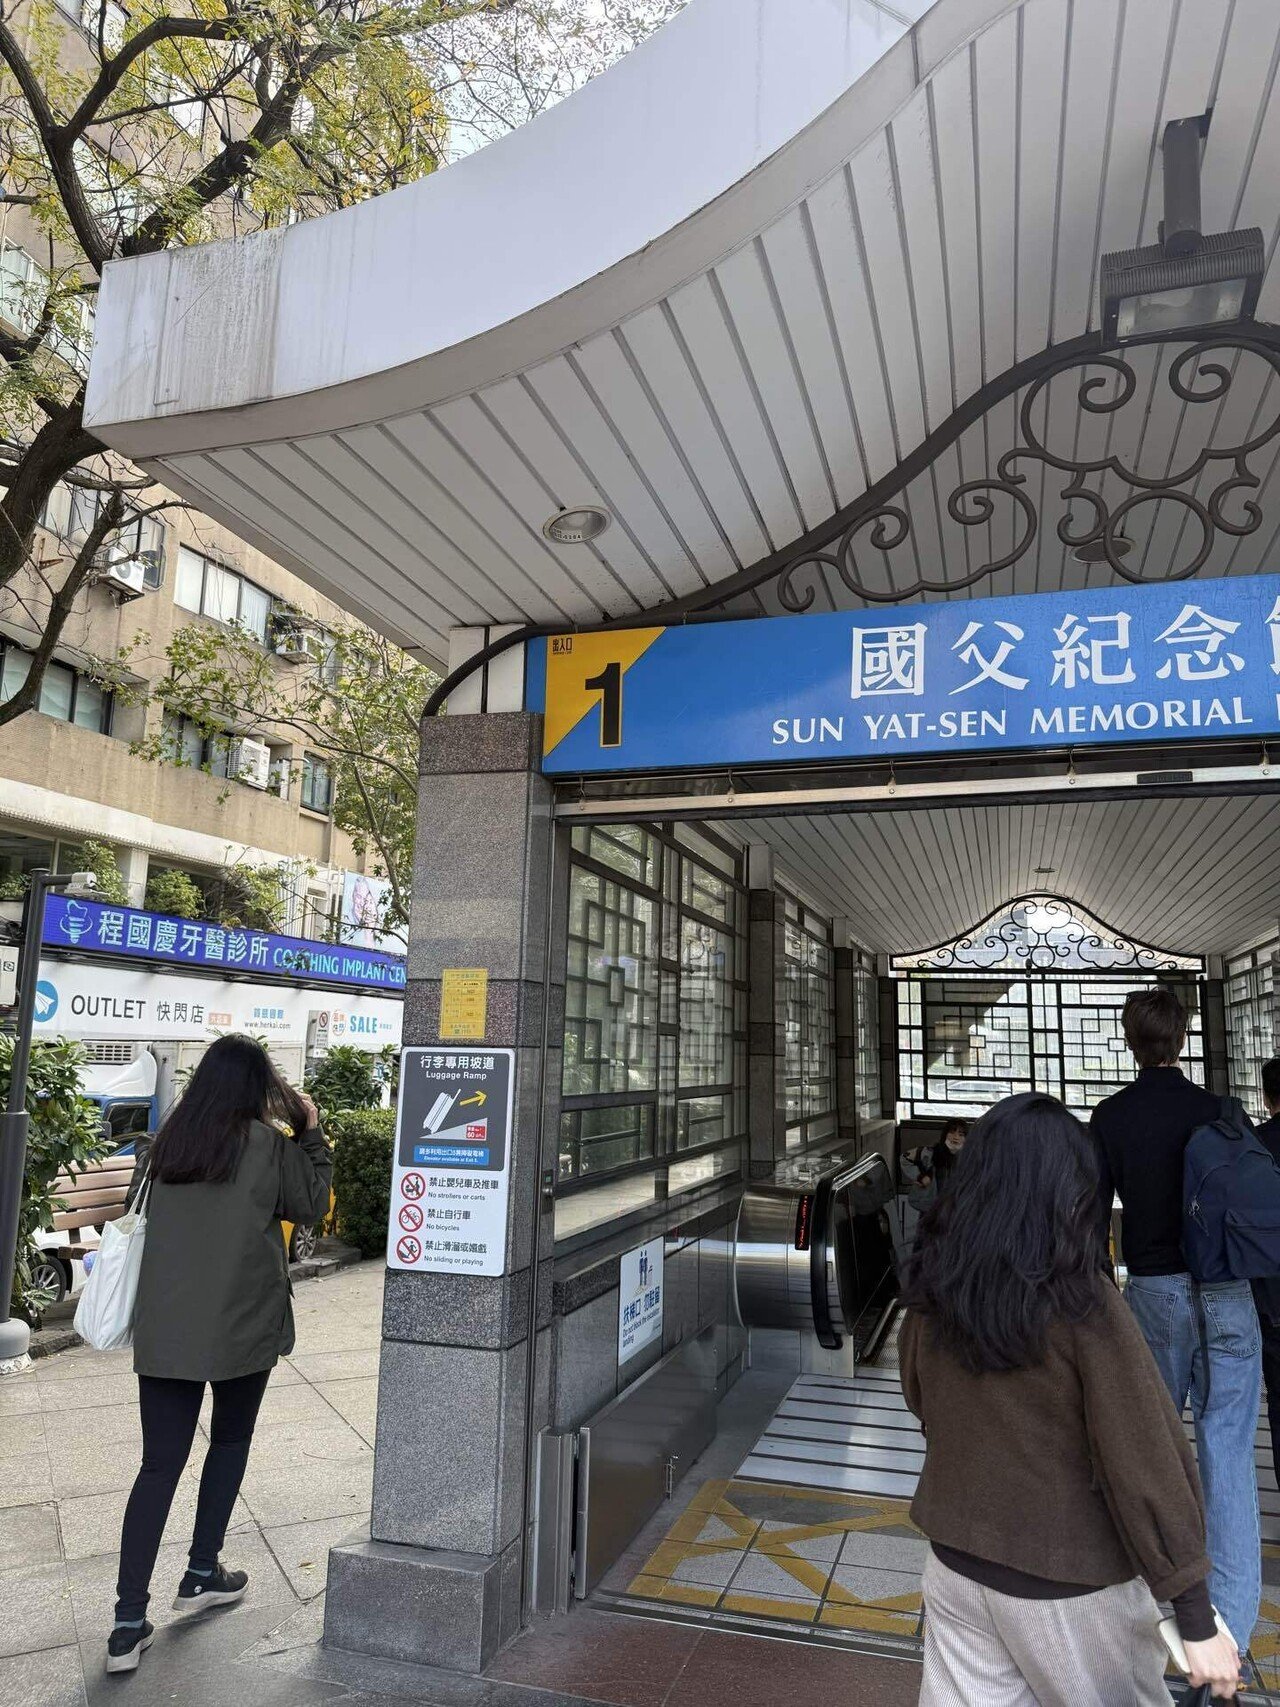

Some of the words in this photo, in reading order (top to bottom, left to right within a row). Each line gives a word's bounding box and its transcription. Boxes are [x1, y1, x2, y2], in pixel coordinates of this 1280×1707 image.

[552, 637, 573, 652] 出入口
[584, 661, 621, 746] 1
[772, 716, 844, 745] SUN
[863, 709, 1007, 740] YAT-SEN
[1030, 696, 1253, 734] MEMORIAL
[97, 909, 270, 967] 程國慶牙醫診所
[71, 994, 147, 1020] OUTLET
[156, 1000, 204, 1025] 快閃店
[350, 1015, 378, 1034] SALE
[420, 1055, 495, 1070] 行李專用坡道
[426, 1071, 461, 1081] Luggage
[463, 1071, 487, 1081] Ramp
[429, 1177, 499, 1189] 禁止嬰兒車及推車
[427, 1208, 471, 1220] 禁止自行車
[434, 1256, 453, 1264] sliding
[461, 1259, 484, 1267] playing
